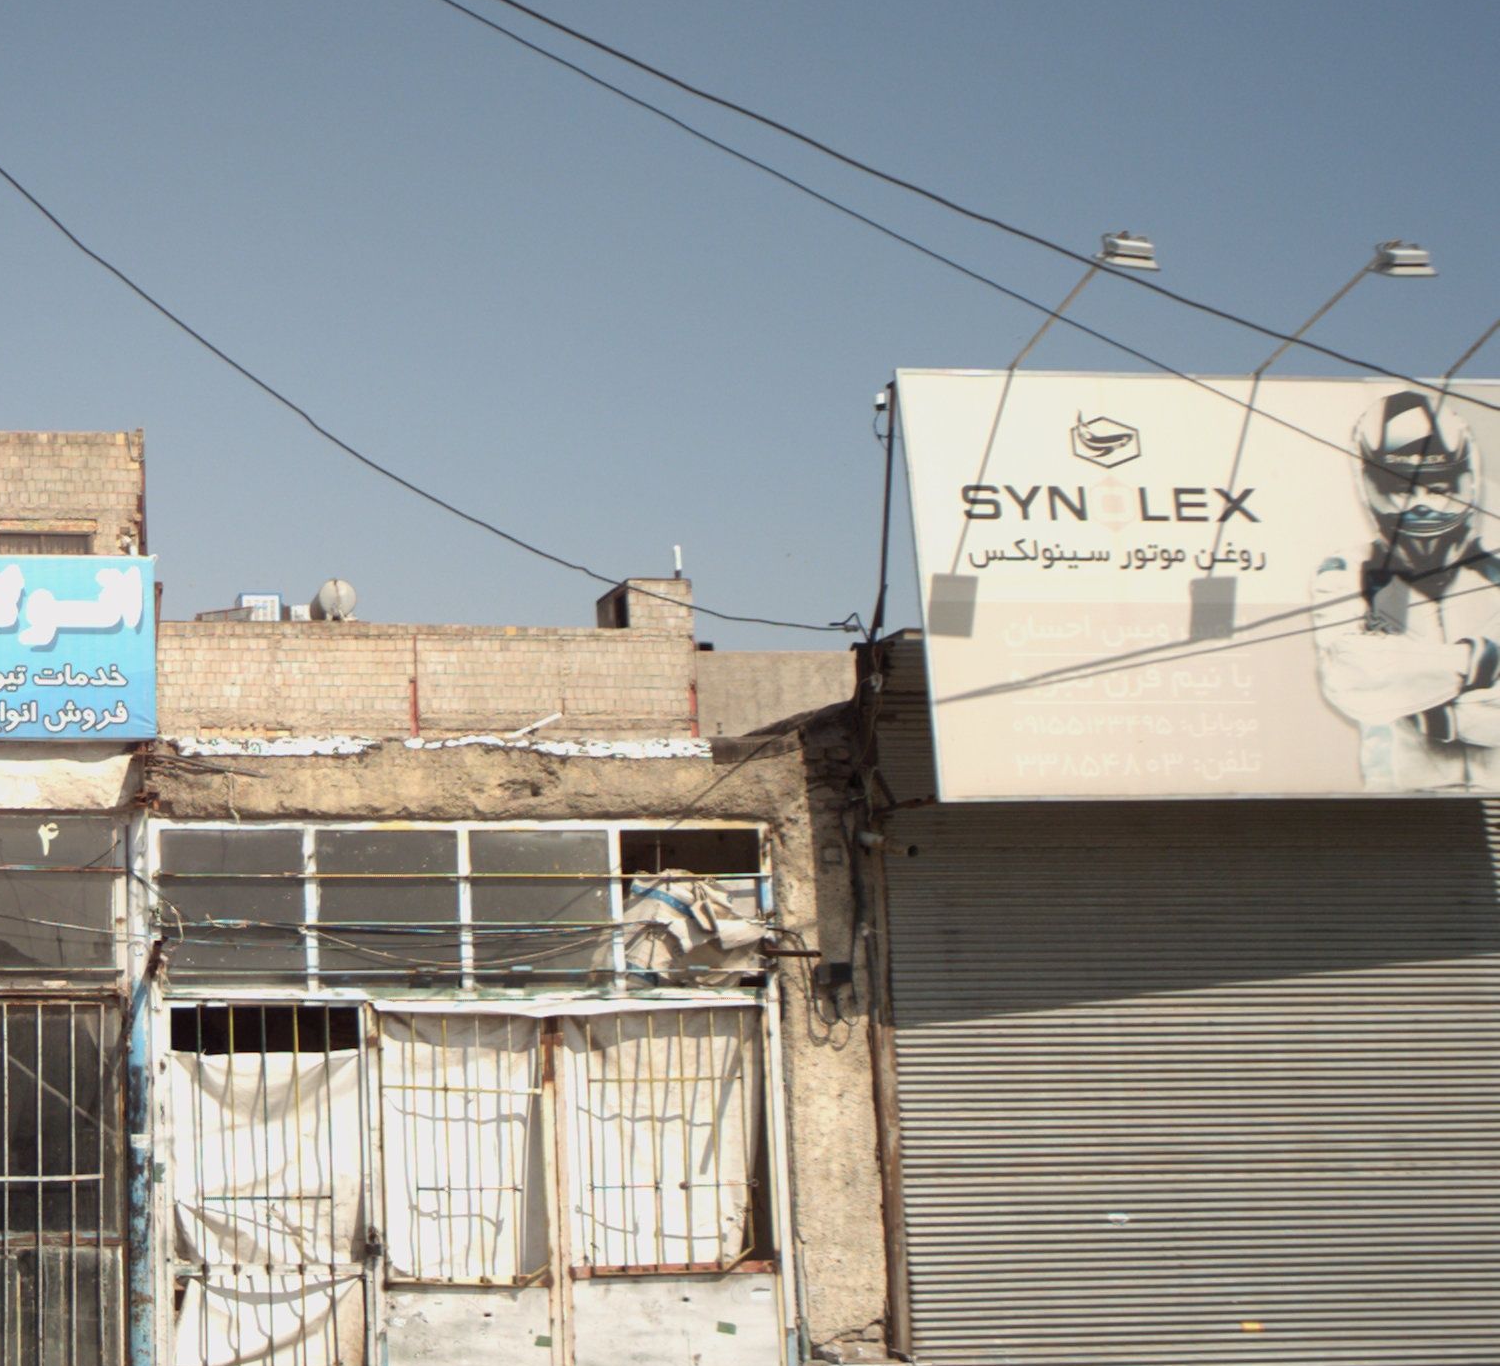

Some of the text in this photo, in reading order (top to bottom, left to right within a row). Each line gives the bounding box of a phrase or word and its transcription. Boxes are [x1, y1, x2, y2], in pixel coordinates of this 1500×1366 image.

[967, 537, 1267, 571] روغن موتور سینولکس
[33, 663, 128, 687] خدمات
[1103, 664, 1162, 699] قرن
[1170, 666, 1223, 697] نیم
[1231, 663, 1253, 697] با
[43, 700, 128, 732] فروش
